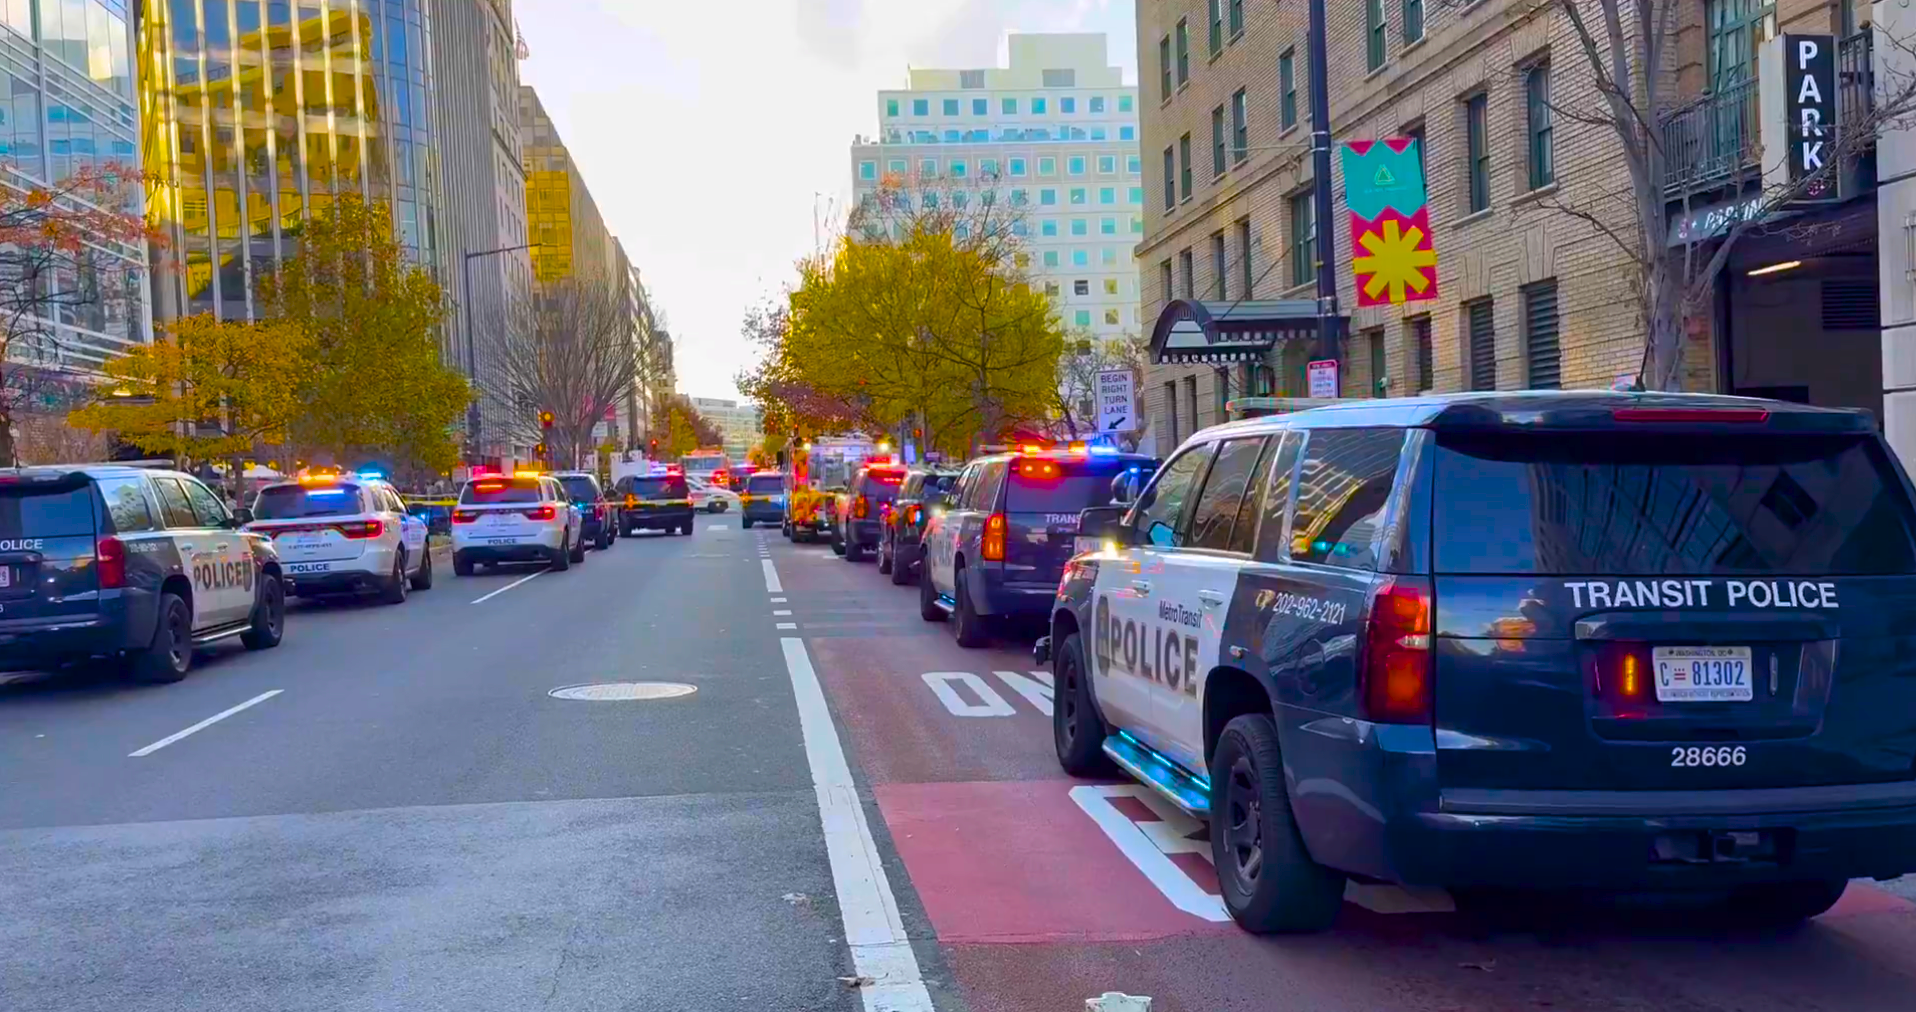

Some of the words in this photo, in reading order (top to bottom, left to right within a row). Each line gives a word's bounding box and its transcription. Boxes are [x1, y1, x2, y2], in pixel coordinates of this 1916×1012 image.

[1797, 41, 1823, 170] PARK
[1101, 374, 1128, 383] BEGIN
[1102, 385, 1127, 393] RIGHT
[1104, 396, 1128, 405] TURN
[1104, 406, 1128, 414] LANE
[193, 560, 242, 591] POLICE
[290, 563, 330, 572] POLICE
[1564, 580, 1712, 608] TRANSIT
[1727, 580, 1840, 608] POLICE
[1273, 592, 1346, 625] 202-962-2121
[1111, 613, 1199, 700] POLICE
[1660, 661, 1670, 687] C
[1692, 660, 1745, 686] 81302
[1671, 746, 1746, 767] 28666
